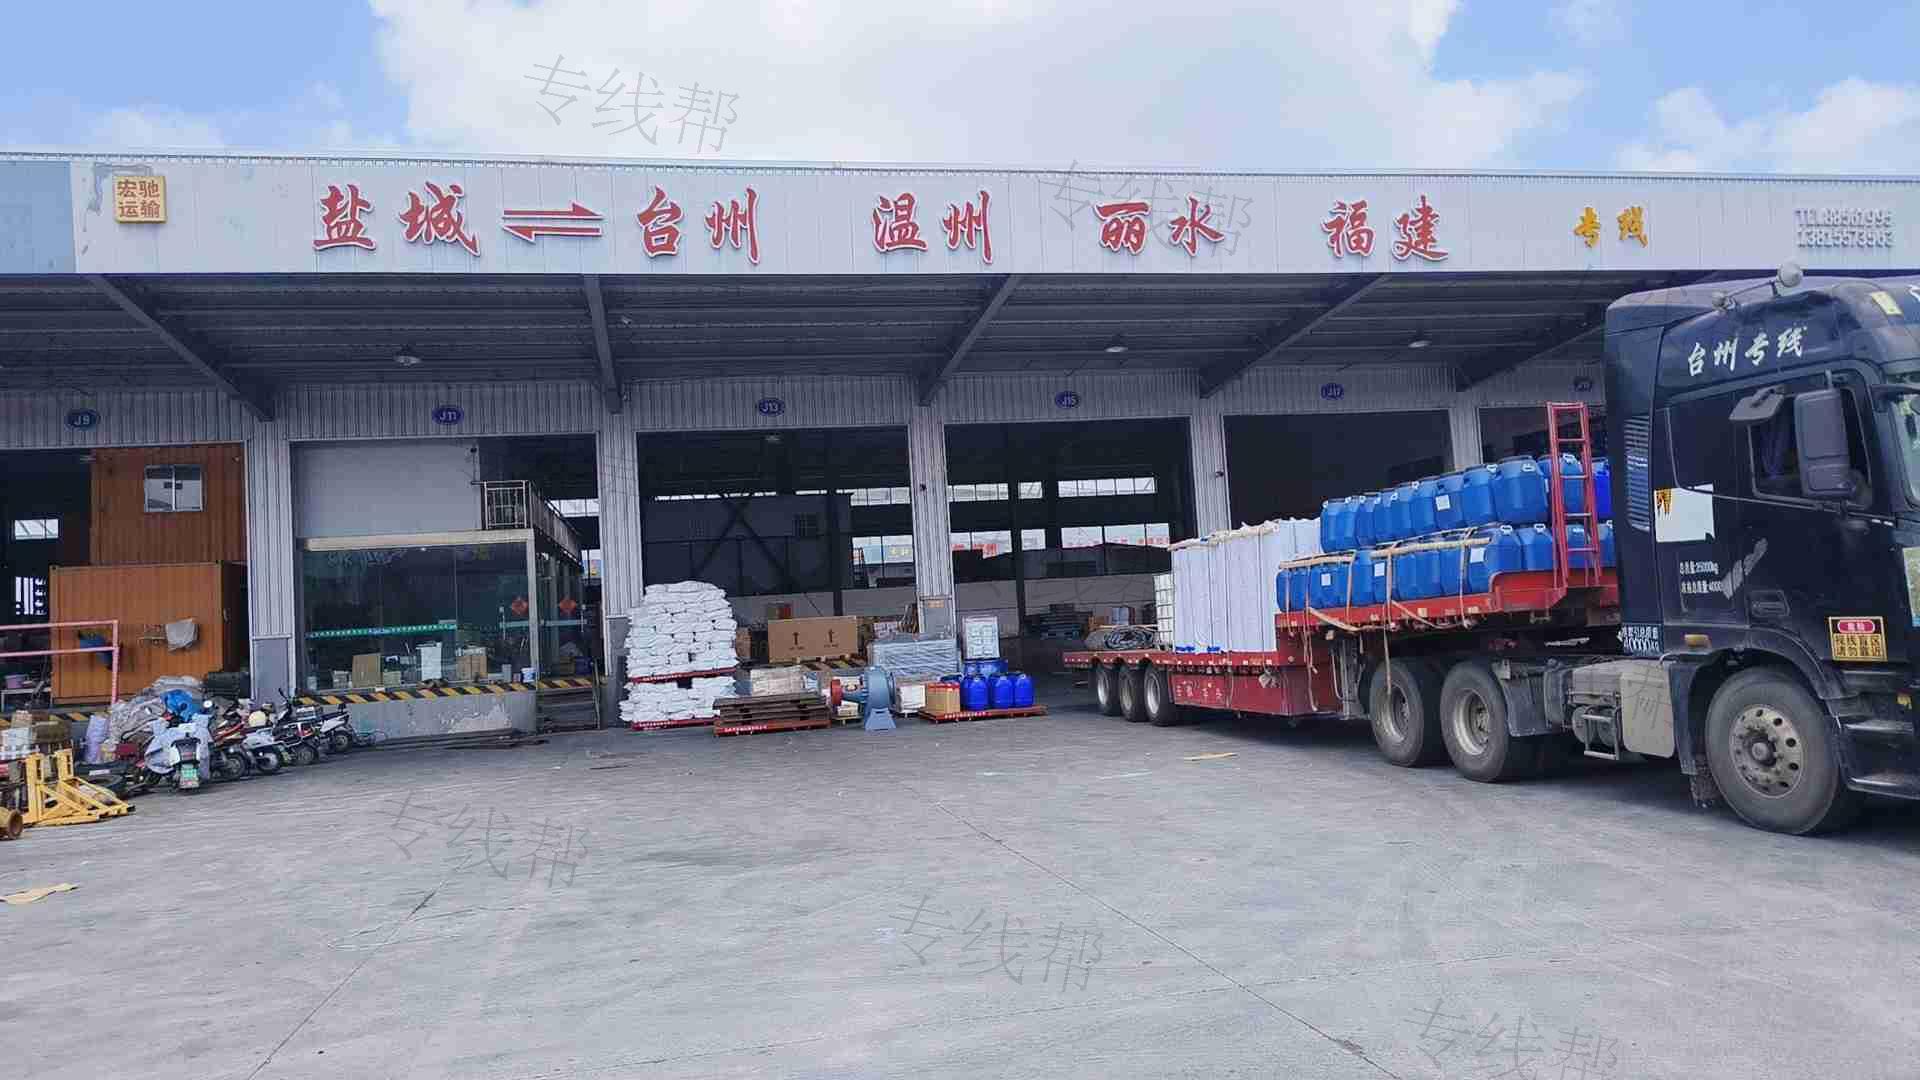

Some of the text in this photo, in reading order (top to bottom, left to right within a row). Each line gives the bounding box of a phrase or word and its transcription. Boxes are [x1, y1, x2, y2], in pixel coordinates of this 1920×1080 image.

[117, 179, 160, 197] 宏驰
[118, 200, 160, 218] 运输
[313, 182, 1649, 264] 盐城 台州 温州 丽水 福建 专线
[1688, 324, 1807, 376] 台州专线
